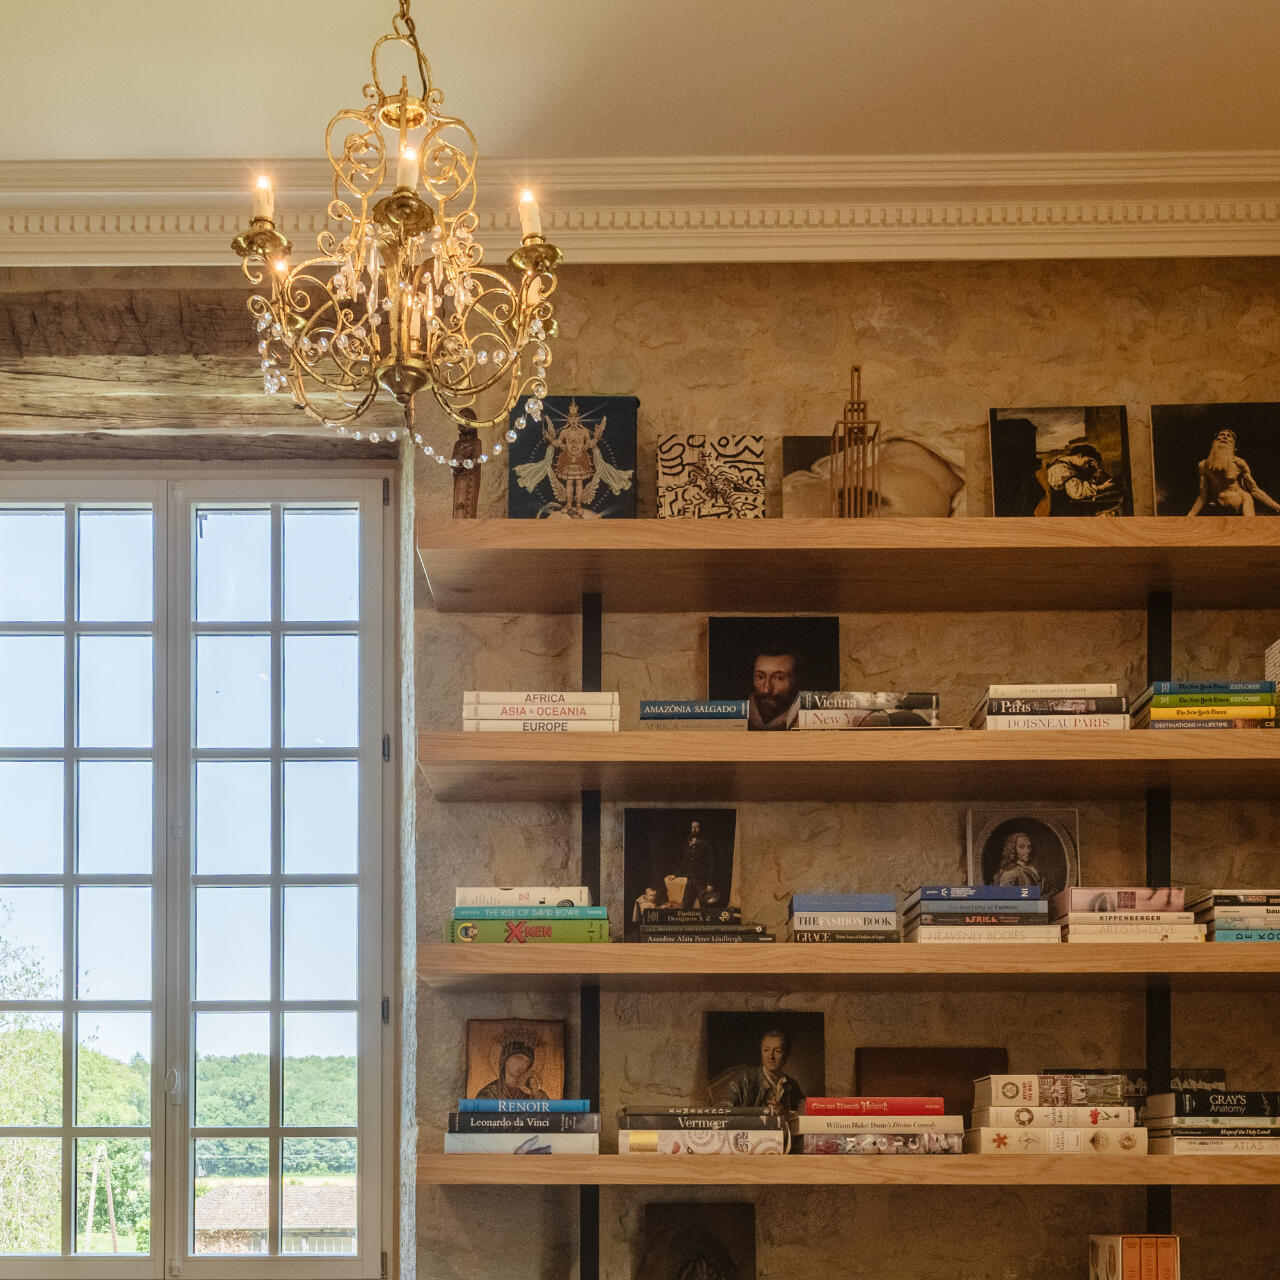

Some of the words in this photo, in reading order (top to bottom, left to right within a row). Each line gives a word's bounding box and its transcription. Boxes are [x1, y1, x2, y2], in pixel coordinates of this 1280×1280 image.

[524, 693, 566, 704] AFRICA
[812, 695, 857, 708] Vienna
[500, 706, 527, 717] ASIA
[536, 706, 588, 717] OCEANIA
[694, 704, 737, 714] SALGADO
[1000, 701, 1032, 713] Paris
[522, 721, 569, 732] EUROPE
[1007, 718, 1071, 729] DOISNEAU
[1073, 718, 1110, 728] PARIS
[505, 920, 553, 943] X-MEN
[796, 931, 832, 942] GRACE
[1209, 1094, 1247, 1105] GRAY'S
[498, 1100, 551, 1113] RENOIR
[1209, 1105, 1246, 1114] Anatomy
[470, 1117, 512, 1128] Leonardo
[513, 1117, 525, 1128] da
[526, 1117, 550, 1128] Vinci
[677, 1116, 729, 1129] Vermeer
[1233, 1142, 1264, 1151] ATLAS
